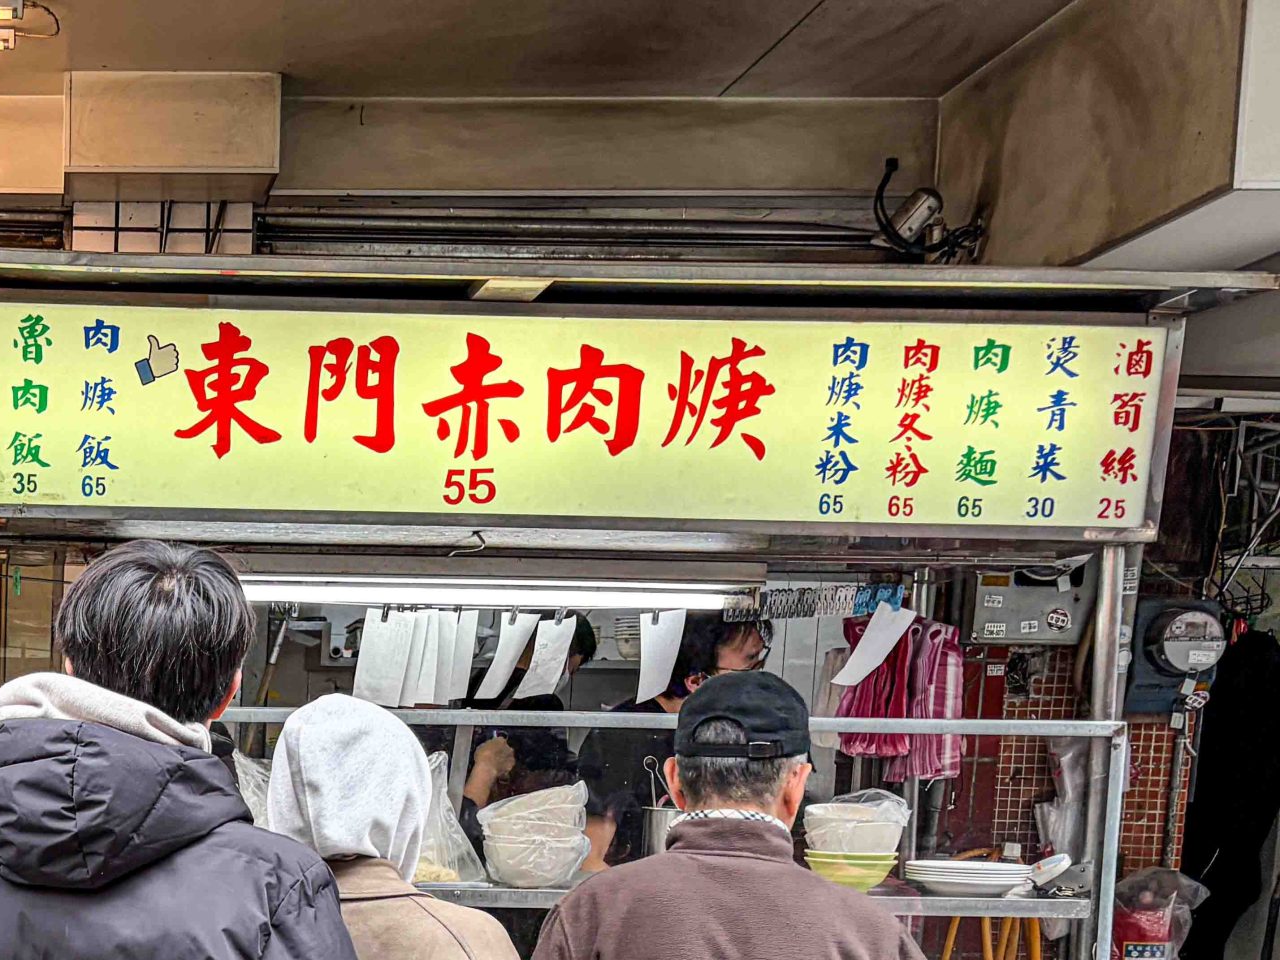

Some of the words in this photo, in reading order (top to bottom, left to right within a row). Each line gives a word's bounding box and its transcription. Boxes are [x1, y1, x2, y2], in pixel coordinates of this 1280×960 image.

[8, 314, 52, 467] 魯肉飯
[76, 319, 120, 469] 肉焿飯
[175, 322, 775, 460] 東門赤肉焿
[815, 337, 870, 484] 肉焿米粉
[886, 338, 941, 488] 肉焿冬粉
[956, 339, 1012, 486] 肉焿麵
[1029, 336, 1079, 484] 燙青菜
[1099, 340, 1153, 484] 滷筍絲
[12, 472, 38, 495] 35
[81, 475, 106, 497] 65
[443, 467, 497, 506] 55
[818, 493, 844, 515] 65
[887, 495, 913, 517] 65
[957, 496, 983, 518] 65
[1025, 497, 1055, 518] 30
[1097, 497, 1125, 519] 25
